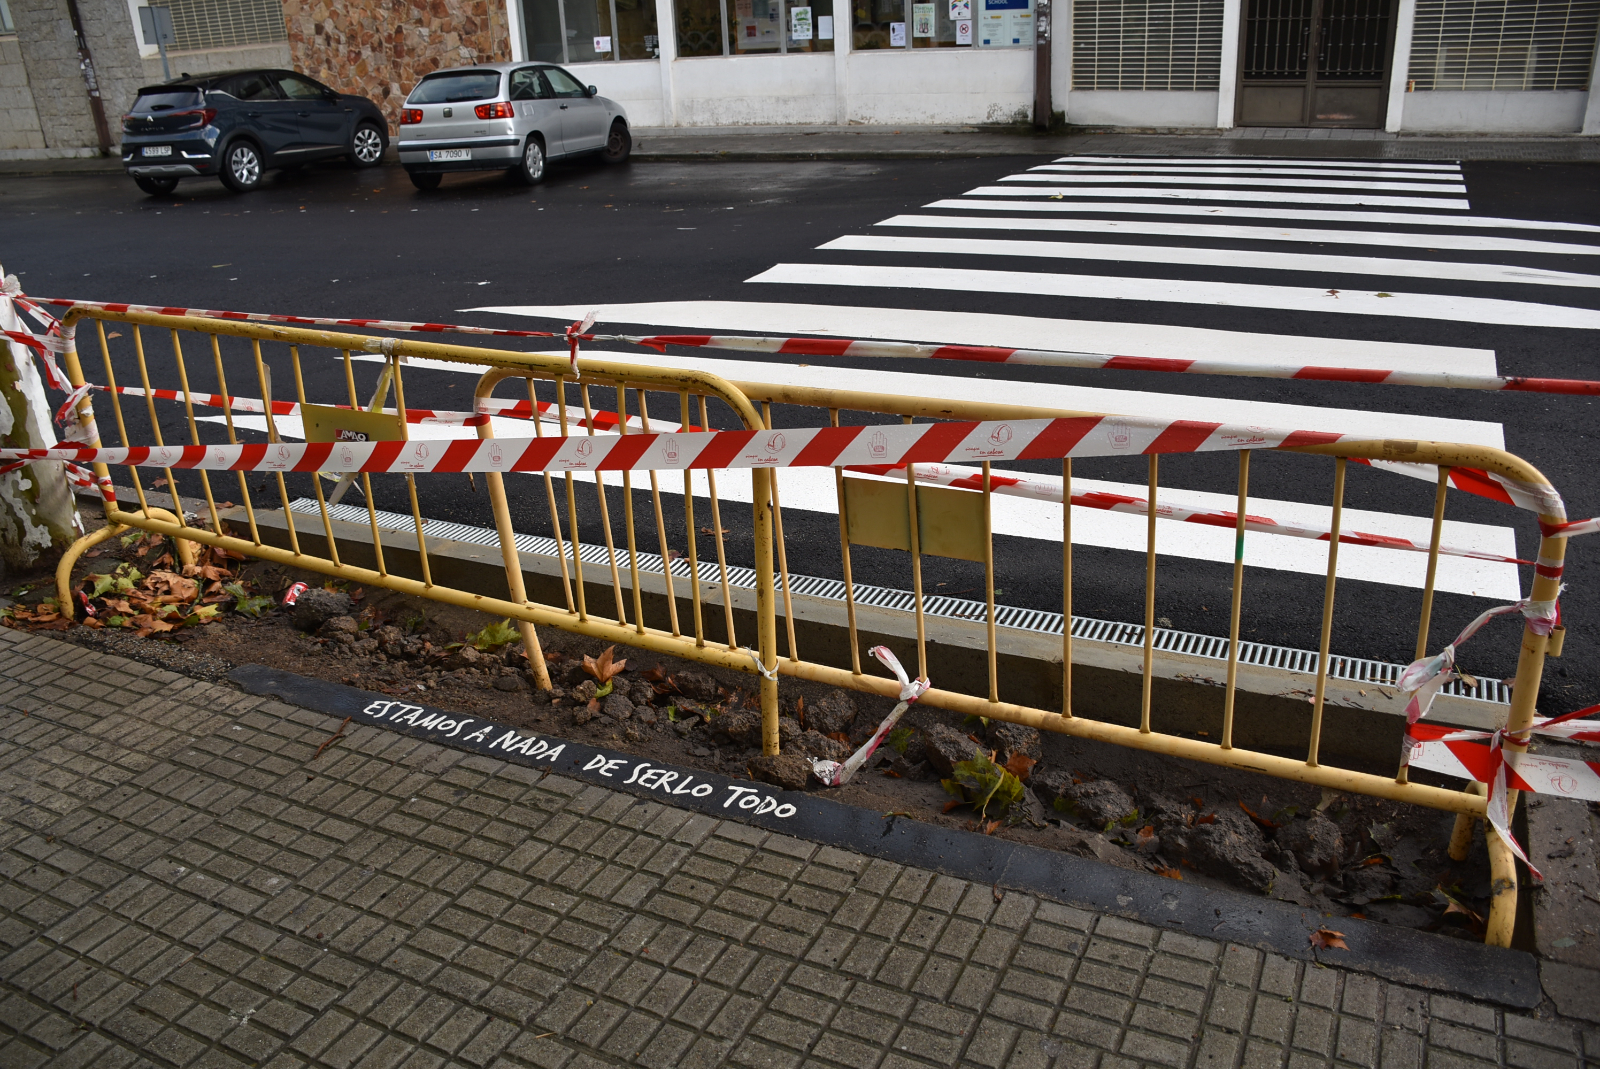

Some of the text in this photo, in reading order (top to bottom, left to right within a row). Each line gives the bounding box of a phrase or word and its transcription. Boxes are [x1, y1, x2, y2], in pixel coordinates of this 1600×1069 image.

[434, 149, 470, 159] SA 7090 V
[363, 700, 797, 818] ESTAMOS A NADA DE SERLO TODO
